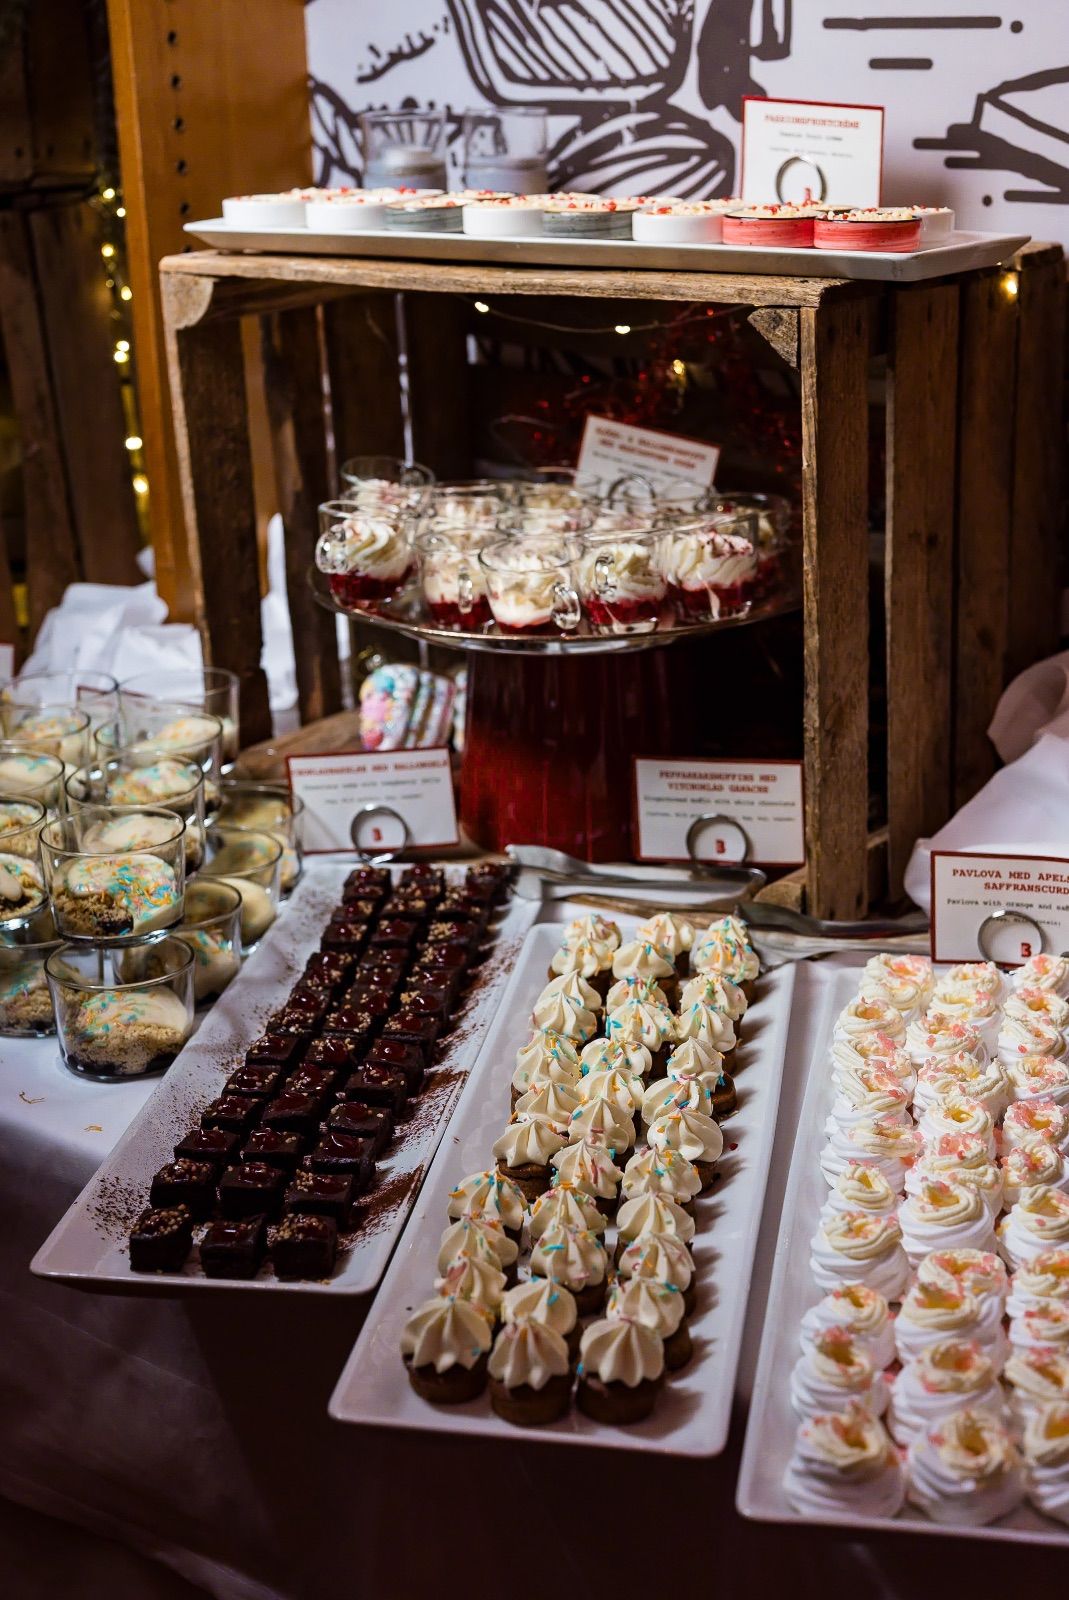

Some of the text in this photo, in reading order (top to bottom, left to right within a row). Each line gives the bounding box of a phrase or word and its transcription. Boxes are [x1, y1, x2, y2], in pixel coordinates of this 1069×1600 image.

[759, 774, 777, 783] MED
[952, 868, 1002, 879] PAVLOVA
[1009, 871, 1031, 880] MED
[984, 882, 1069, 895] SAFFRANSCURD
[947, 898, 979, 906] Pavlova
[983, 899, 1002, 907] with
[1006, 902, 1034, 910] orange
[1038, 902, 1053, 910] and
[1021, 942, 1032, 958] B
